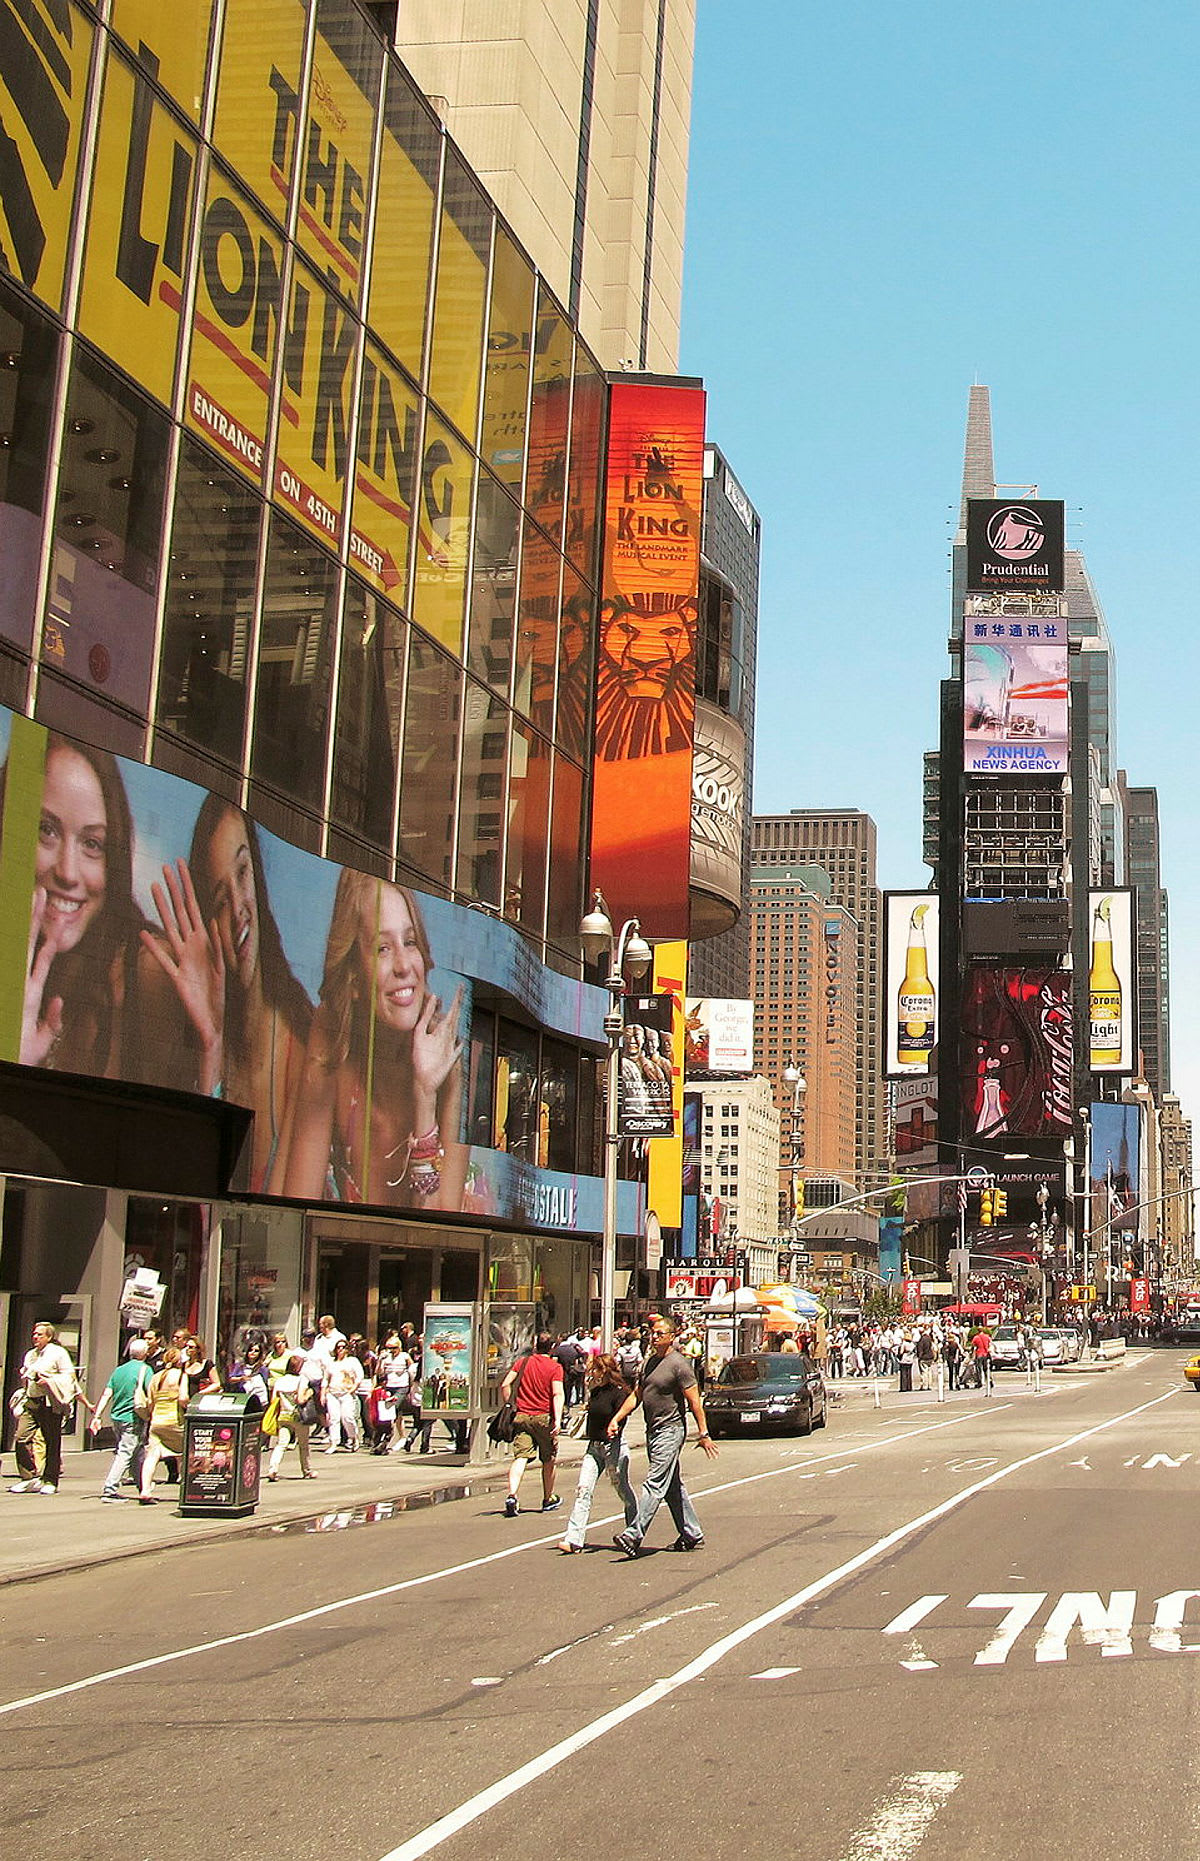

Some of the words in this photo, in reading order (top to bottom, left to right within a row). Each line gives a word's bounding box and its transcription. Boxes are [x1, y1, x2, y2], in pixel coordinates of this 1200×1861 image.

[268, 64, 365, 262] THE
[116, 40, 302, 398] LION
[309, 266, 455, 530] KING
[194, 391, 263, 467] ENTRANCE
[280, 470, 300, 502] ON
[306, 495, 336, 534] 45TH
[350, 532, 384, 574] STREET
[623, 475, 684, 503] LION
[617, 507, 689, 541] KING
[637, 543, 689, 553] LANDMARK
[617, 551, 656, 560] MUSICAL
[658, 552, 688, 561] EVENT
[982, 563, 1049, 576] Prudential
[974, 623, 1058, 638] 新华通讯社
[986, 746, 1047, 759] XINHUA
[972, 759, 1008, 770] NEWS
[1010, 759, 1061, 770] AGENCY
[692, 773, 743, 820] KOOK
[901, 995, 932, 1007] Corona
[996, 1173, 1032, 1182] LAUNCH
[1033, 1173, 1060, 1182] GAME
